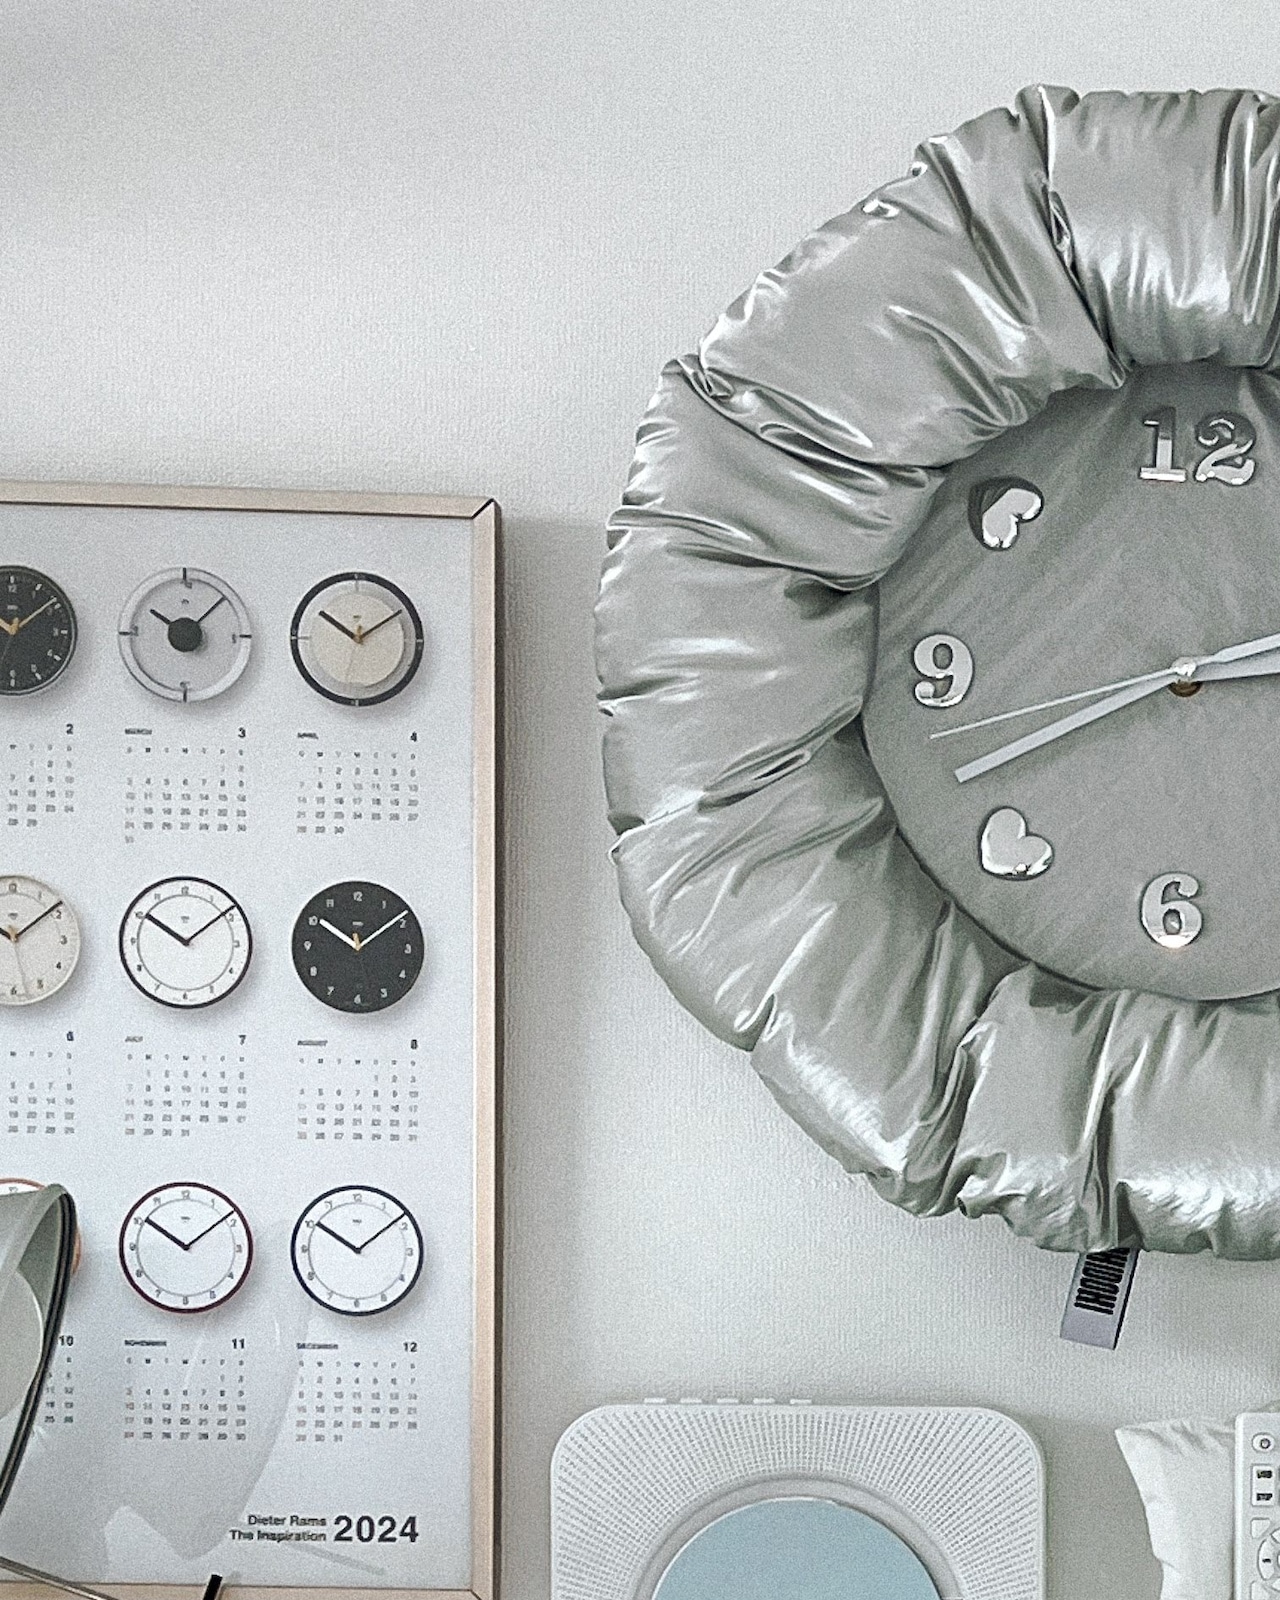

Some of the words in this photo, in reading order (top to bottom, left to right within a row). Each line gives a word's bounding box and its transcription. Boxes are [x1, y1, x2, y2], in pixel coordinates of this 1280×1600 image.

[1140, 406, 1256, 485] 12
[913, 634, 974, 708] 9
[66, 724, 73, 734] 2
[238, 727, 246, 738] 3
[410, 731, 417, 742] 4
[1141, 872, 1202, 948] 6
[238, 1035, 246, 1045] 7
[232, 1339, 245, 1349] 11
[403, 1342, 417, 1352] 12
[248, 1515, 286, 1526] Dieter
[290, 1515, 326, 1526] Rams
[334, 1515, 419, 1543] 2024
[230, 1530, 254, 1540] The
[257, 1530, 326, 1543] Inspiration
